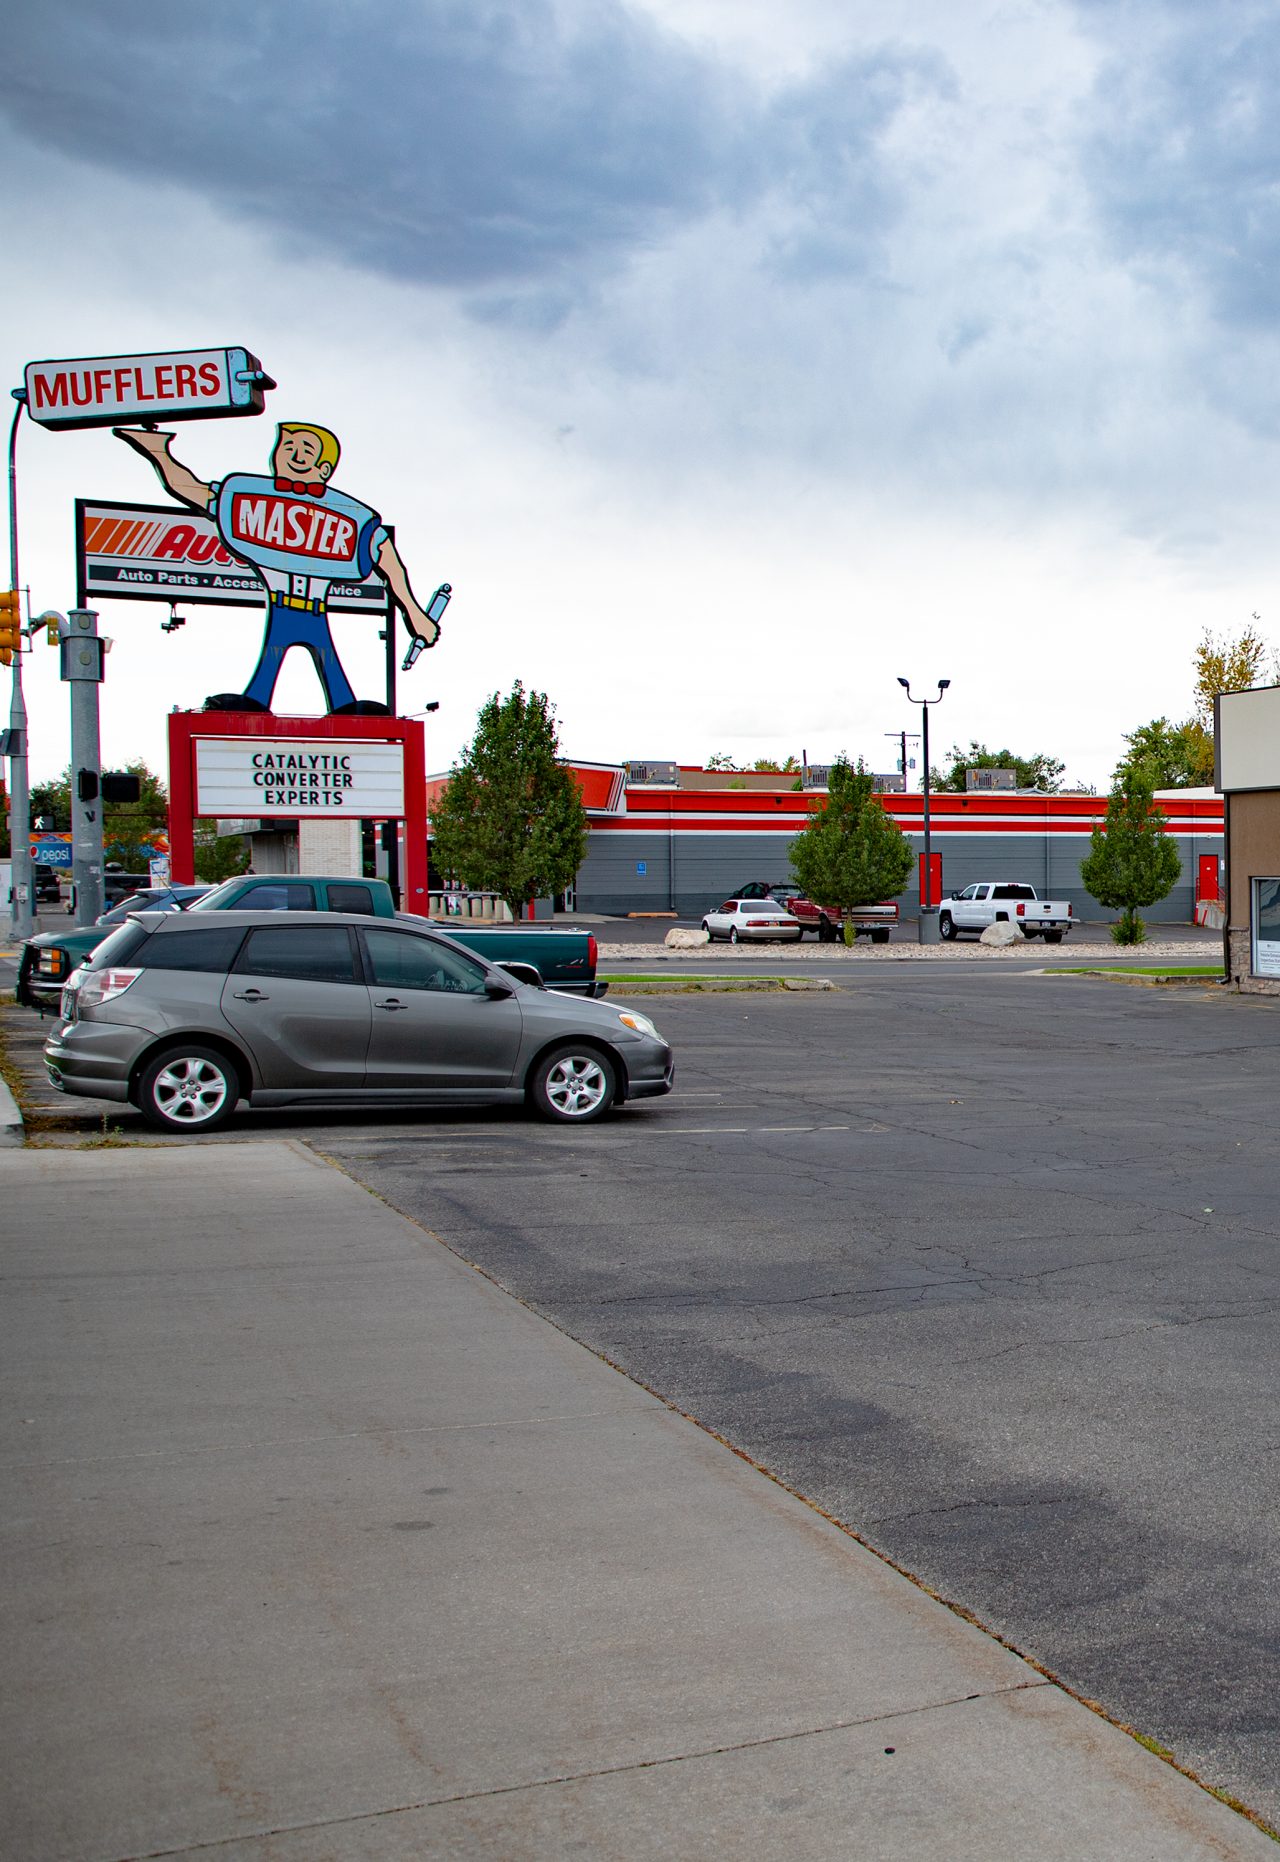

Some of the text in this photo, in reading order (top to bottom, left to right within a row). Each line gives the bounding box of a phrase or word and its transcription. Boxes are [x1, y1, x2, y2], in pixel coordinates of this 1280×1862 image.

[33, 362, 221, 409] MUFFLERS
[239, 499, 354, 556] MASTER
[151, 524, 251, 567] Au
[117, 569, 154, 582] Auto
[157, 571, 199, 585] Parts
[252, 753, 351, 770] CATALYTIC
[253, 772, 353, 788] CONVERTER
[264, 790, 343, 805] EXPERTS
[41, 847, 70, 863] pepsi
